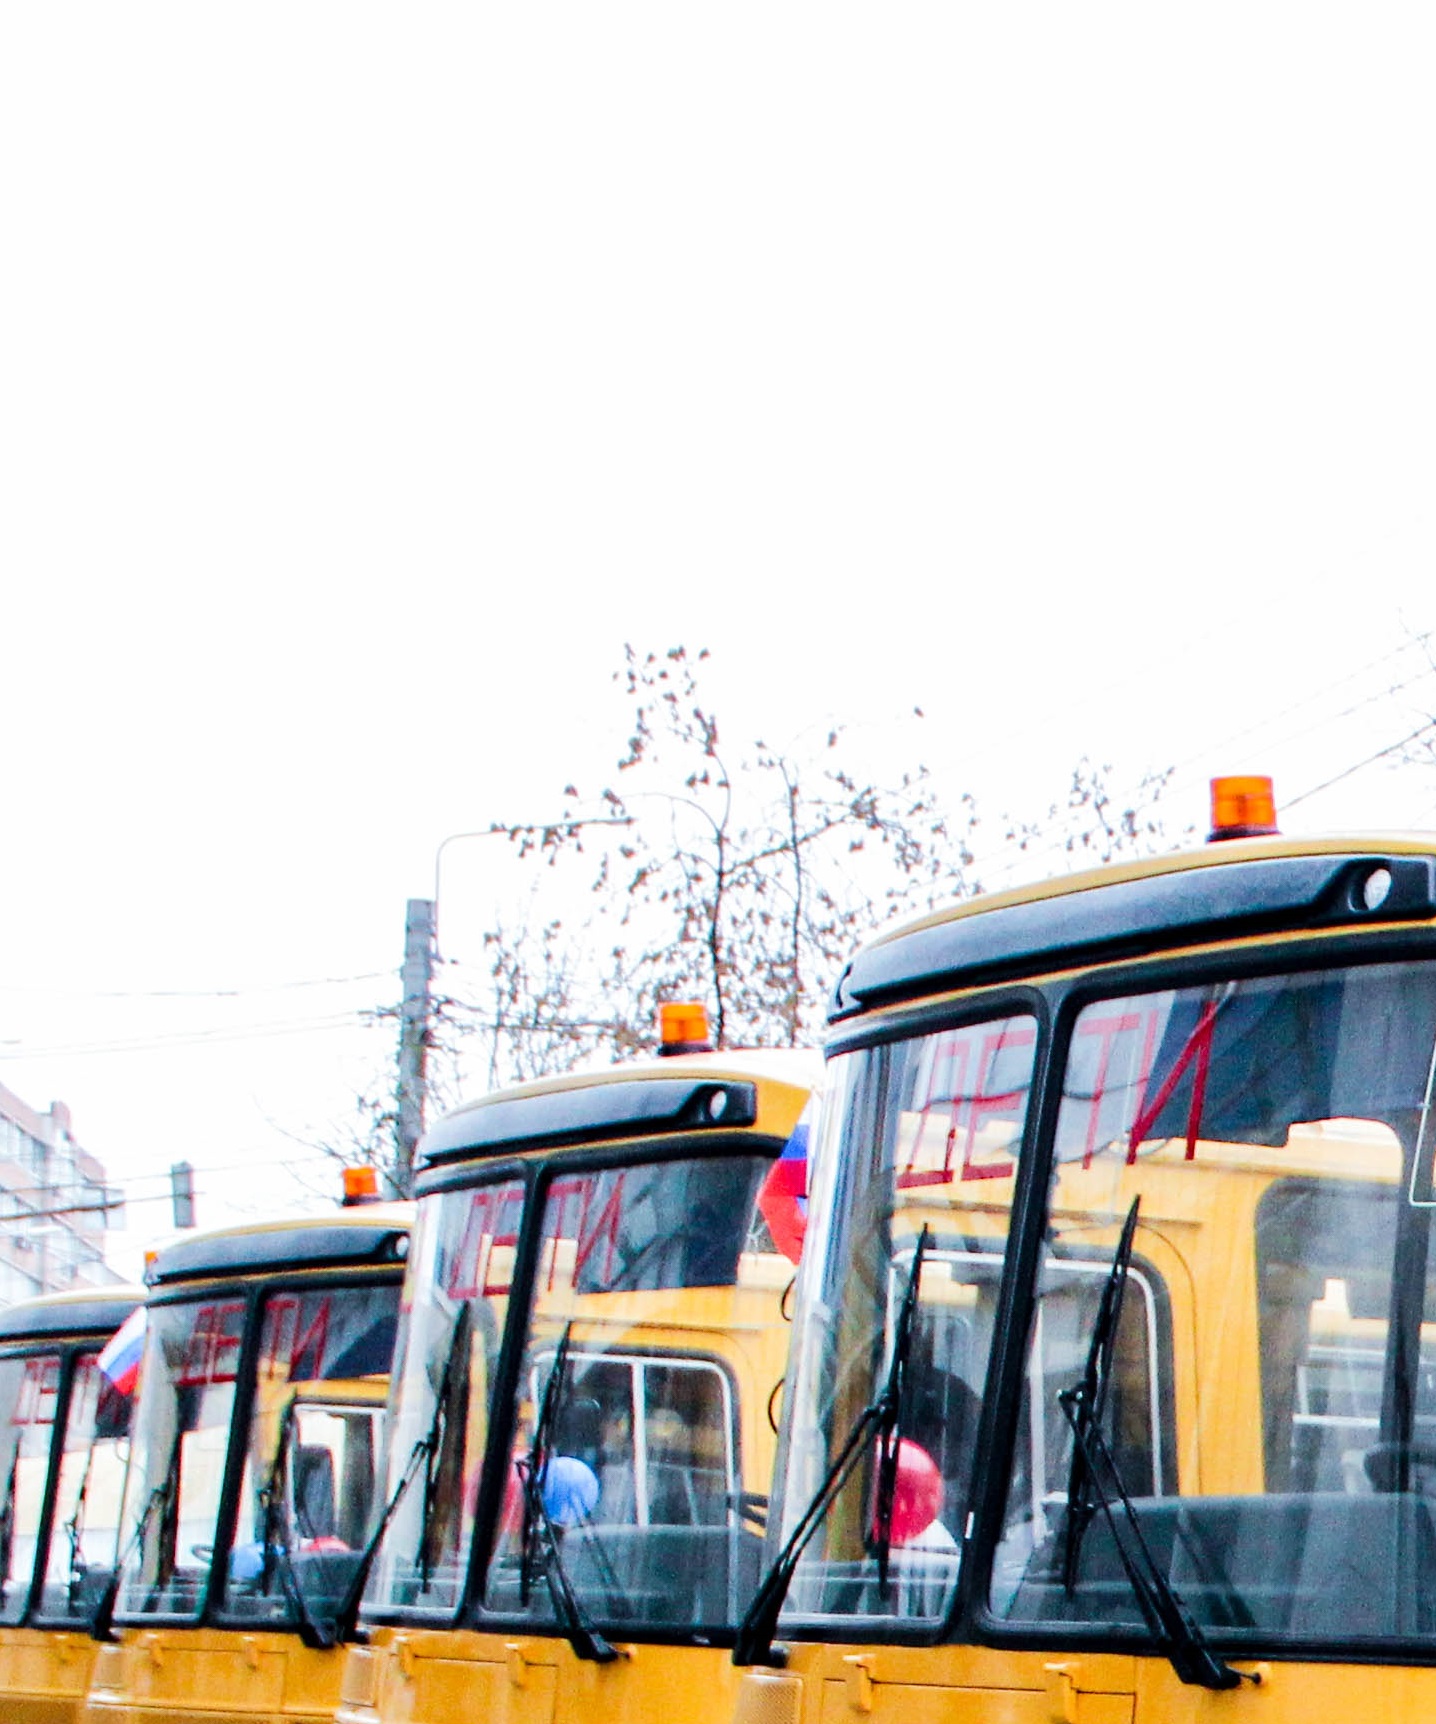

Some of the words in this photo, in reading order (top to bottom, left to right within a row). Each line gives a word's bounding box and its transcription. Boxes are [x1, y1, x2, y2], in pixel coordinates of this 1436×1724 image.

[896, 1001, 1216, 1188] ДЕТИ
[448, 1174, 624, 1298] ДЕТИ
[177, 1297, 330, 1386] ДЕТИ
